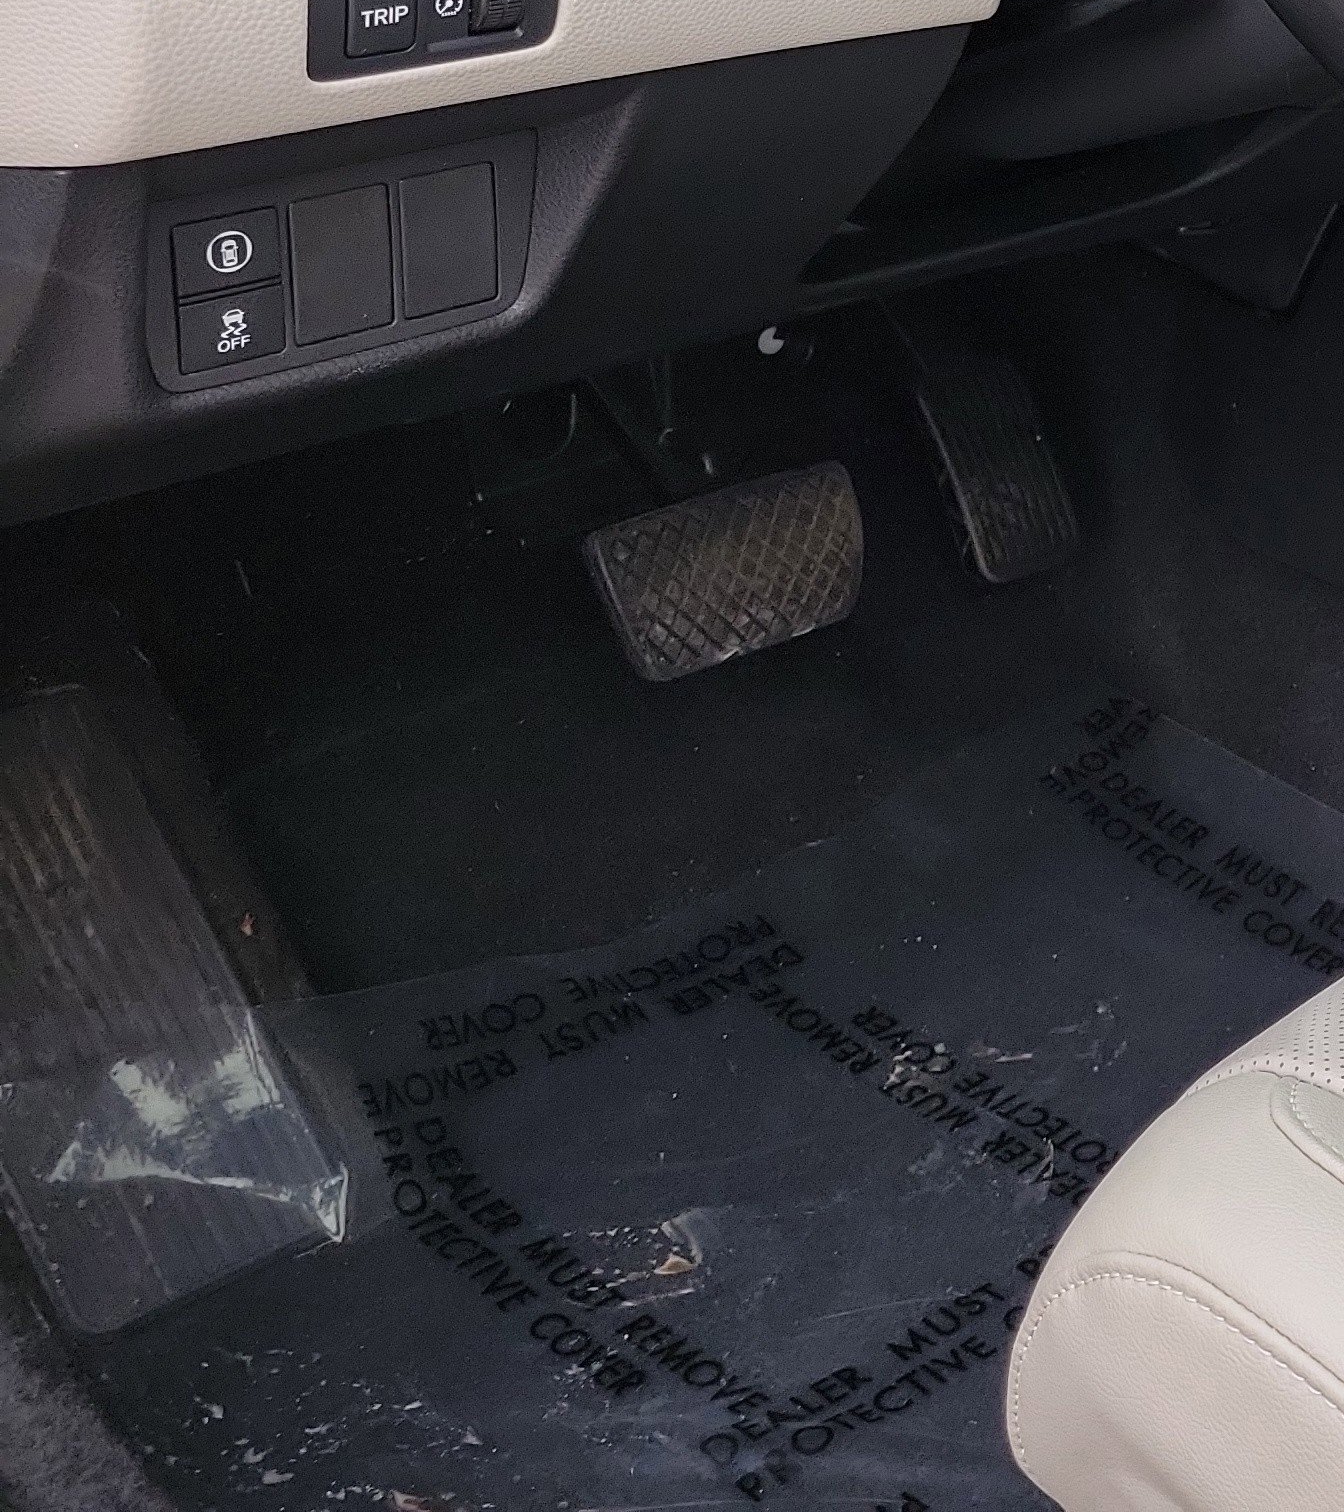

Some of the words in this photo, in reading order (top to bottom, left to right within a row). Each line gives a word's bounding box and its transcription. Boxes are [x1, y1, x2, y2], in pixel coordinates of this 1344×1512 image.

[360, 4, 409, 29] TRIP
[217, 333, 251, 354] OFF
[1066, 789, 1243, 915] PROTECTIVE
[1101, 772, 1210, 850] DEALER
[1213, 844, 1308, 906] MUST
[418, 992, 546, 1050] COVER
[667, 941, 806, 1016] DEALER
[538, 1001, 650, 1061] MUST
[749, 982, 882, 1074] REMOVE
[358, 1049, 518, 1119] REMOVE
[878, 1084, 979, 1133] MUST
[952, 1070, 1120, 1175] ROTECTIVE
[373, 1126, 538, 1311] PROTECTIVE
[529, 1312, 648, 1396] COVER
[415, 1116, 523, 1234] DEALER
[518, 1236, 629, 1311] MUST
[616, 1313, 771, 1416] REMOVE
[700, 1365, 873, 1465] DEALER
[886, 1282, 1005, 1362] MUST
[736, 1333, 999, 1502] PROTECTIVE
